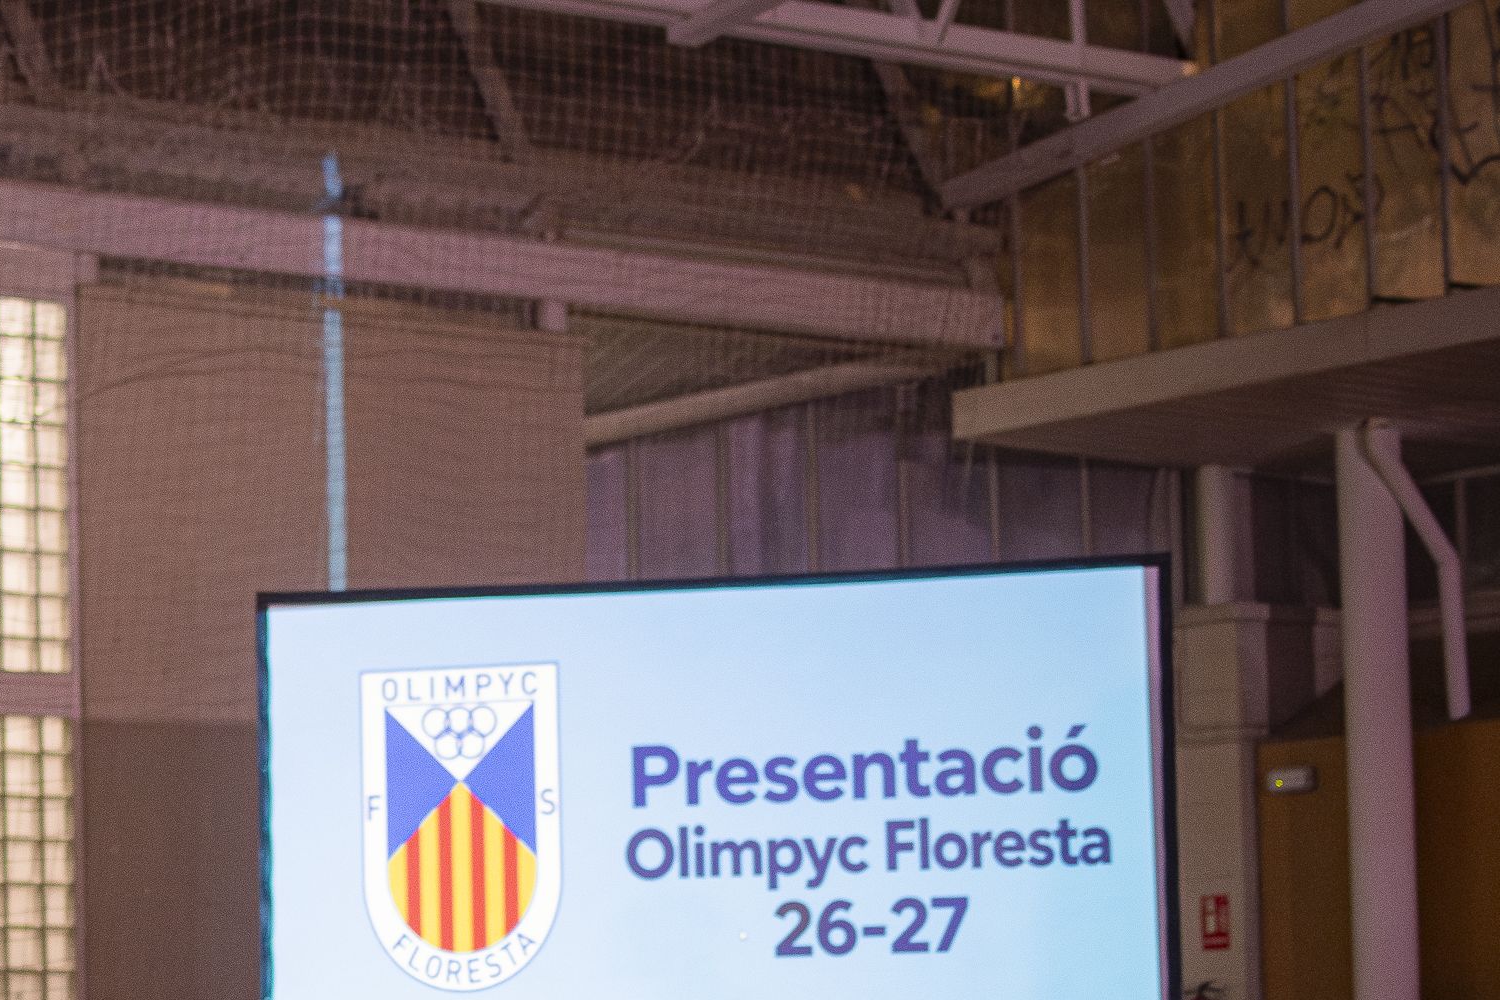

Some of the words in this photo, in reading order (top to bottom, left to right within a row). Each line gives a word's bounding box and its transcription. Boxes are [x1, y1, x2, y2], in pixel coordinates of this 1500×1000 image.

[381, 671, 538, 702] OLIMPYC
[631, 722, 1102, 809] Presentació
[367, 795, 380, 821] F
[540, 788, 556, 815] S
[625, 824, 869, 891] Olimpyc
[884, 816, 1116, 872] Floresta
[774, 895, 970, 958] 26-27
[393, 932, 536, 985] FLORESTA
